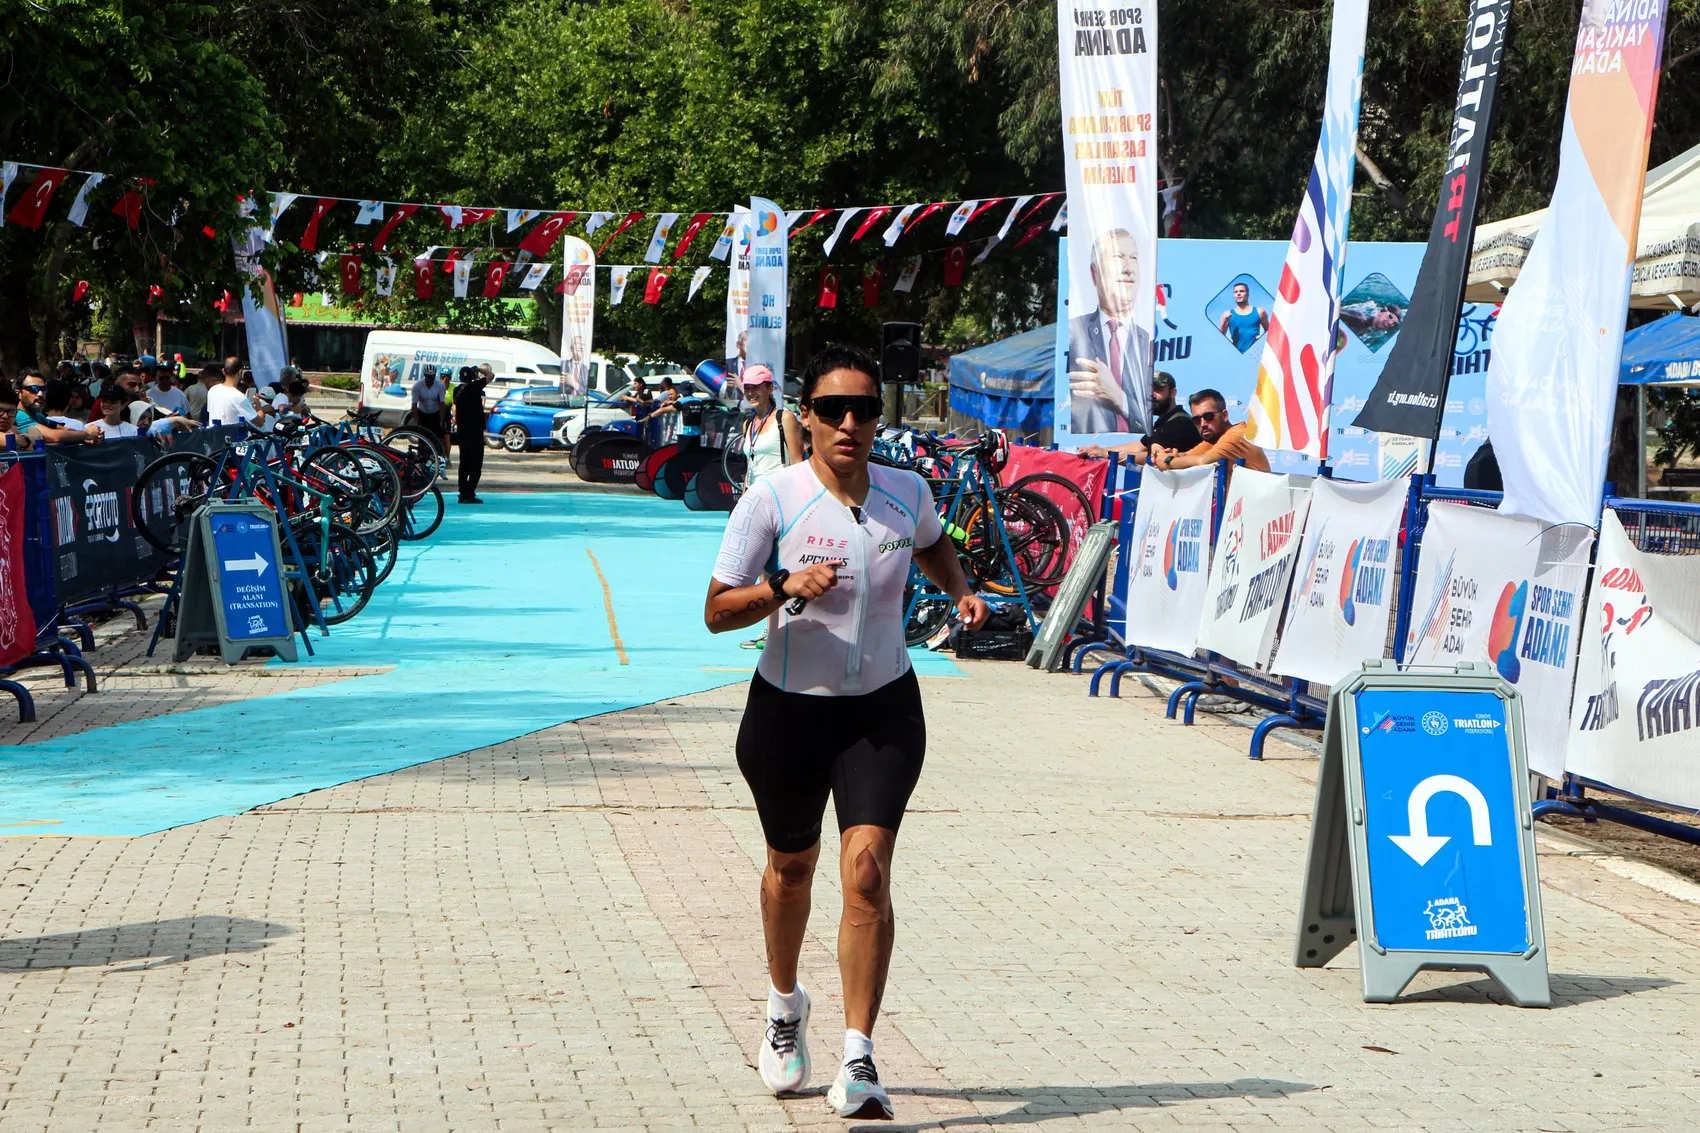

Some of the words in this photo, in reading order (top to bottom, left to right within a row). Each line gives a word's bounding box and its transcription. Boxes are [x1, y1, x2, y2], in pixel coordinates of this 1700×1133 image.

[414, 350, 439, 362] SPOR
[807, 535, 849, 549] RISE
[1452, 576, 1478, 601] BÜYÜK
[230, 601, 278, 611] (TRANSATION)
[1531, 584, 1552, 615] SPOR
[1521, 616, 1570, 669] ADANA
[1453, 719, 1493, 729] TRIATLON
